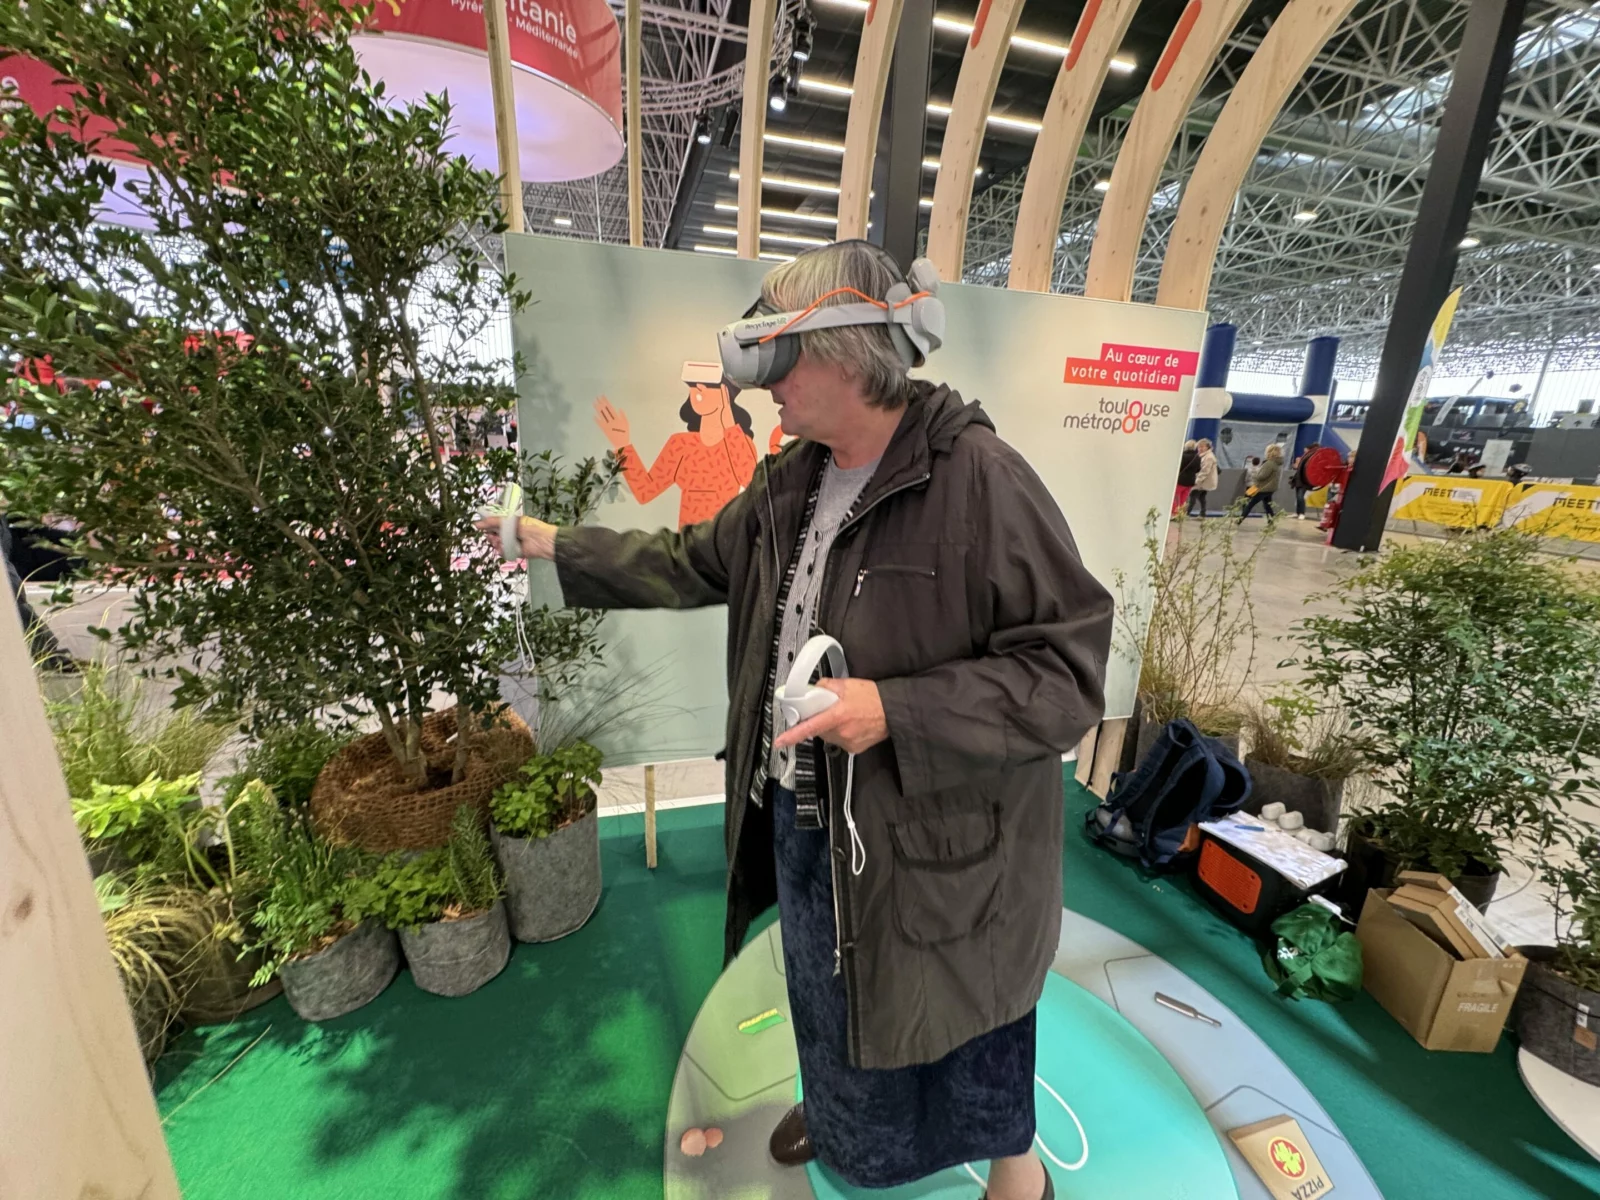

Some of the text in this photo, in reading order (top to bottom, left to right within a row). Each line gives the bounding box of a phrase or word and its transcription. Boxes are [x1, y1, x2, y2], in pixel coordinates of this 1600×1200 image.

[505, 0, 577, 44] itanie
[515, 15, 579, 59] Méditerranée
[1105, 347, 1179, 368] Au cœur de
[1071, 366, 1176, 386] votre quotidien
[1098, 397, 1170, 419] toulouse
[1063, 413, 1151, 434] métropole
[1457, 1002, 1499, 1014] FRAGILE
[1291, 1175, 1325, 1200] PIZZA
